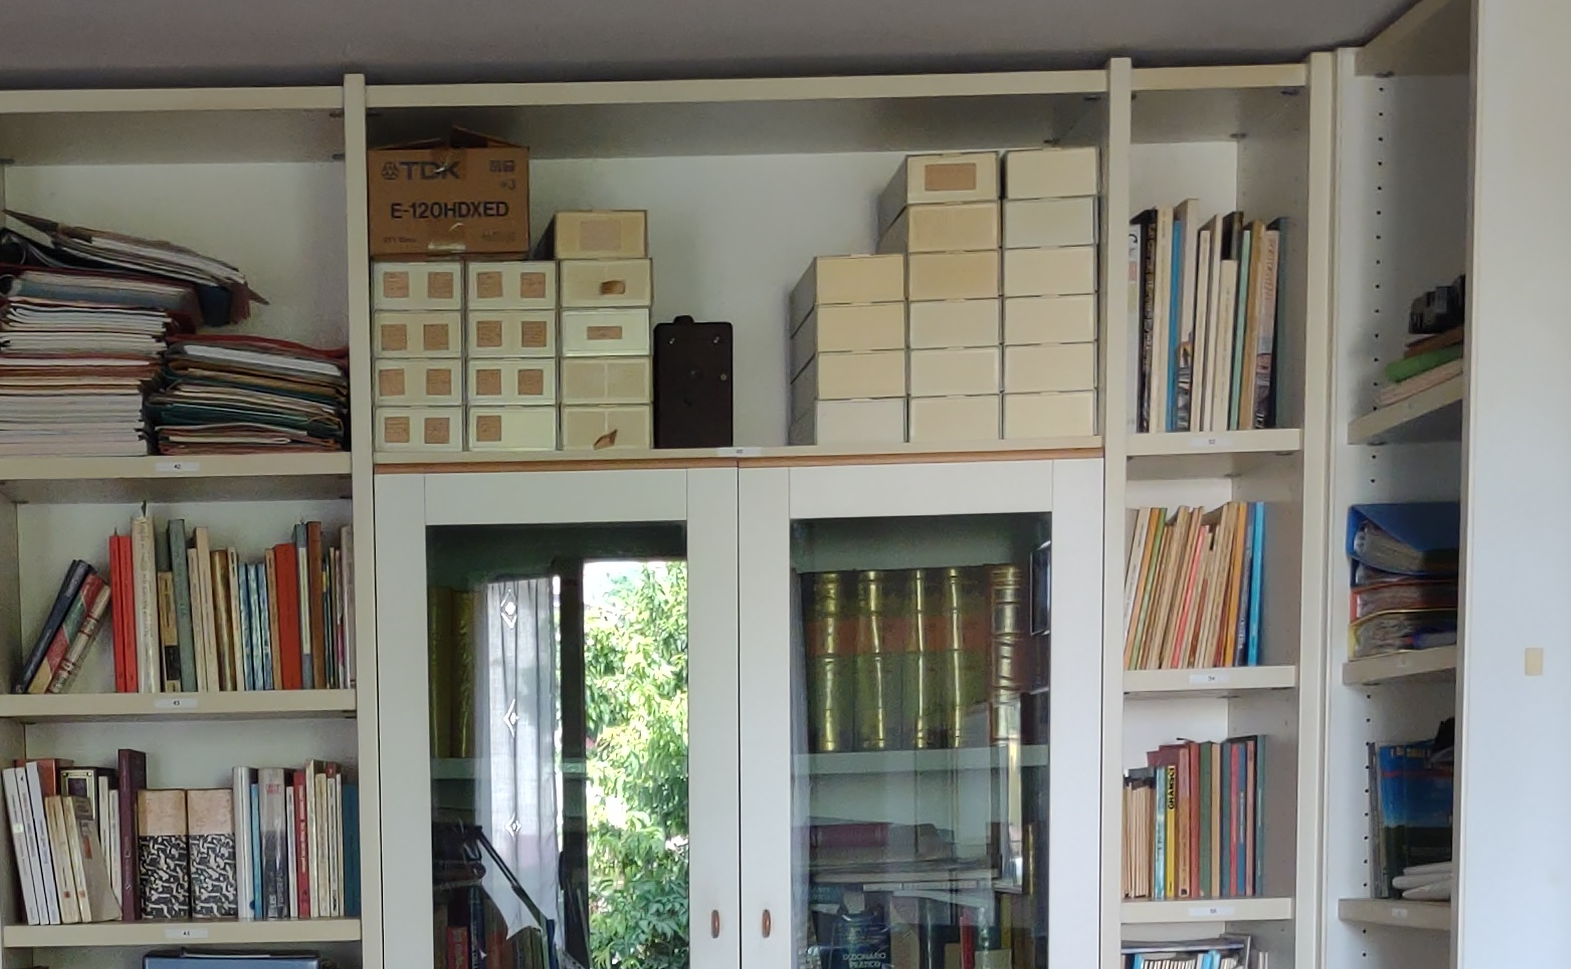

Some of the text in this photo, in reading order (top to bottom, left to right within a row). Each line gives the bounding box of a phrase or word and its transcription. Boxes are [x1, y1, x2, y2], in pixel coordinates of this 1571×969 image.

[399, 161, 460, 180] TDK
[391, 201, 509, 219] E-120HDXED
[1167, 766, 1175, 810] GRAMSCI
